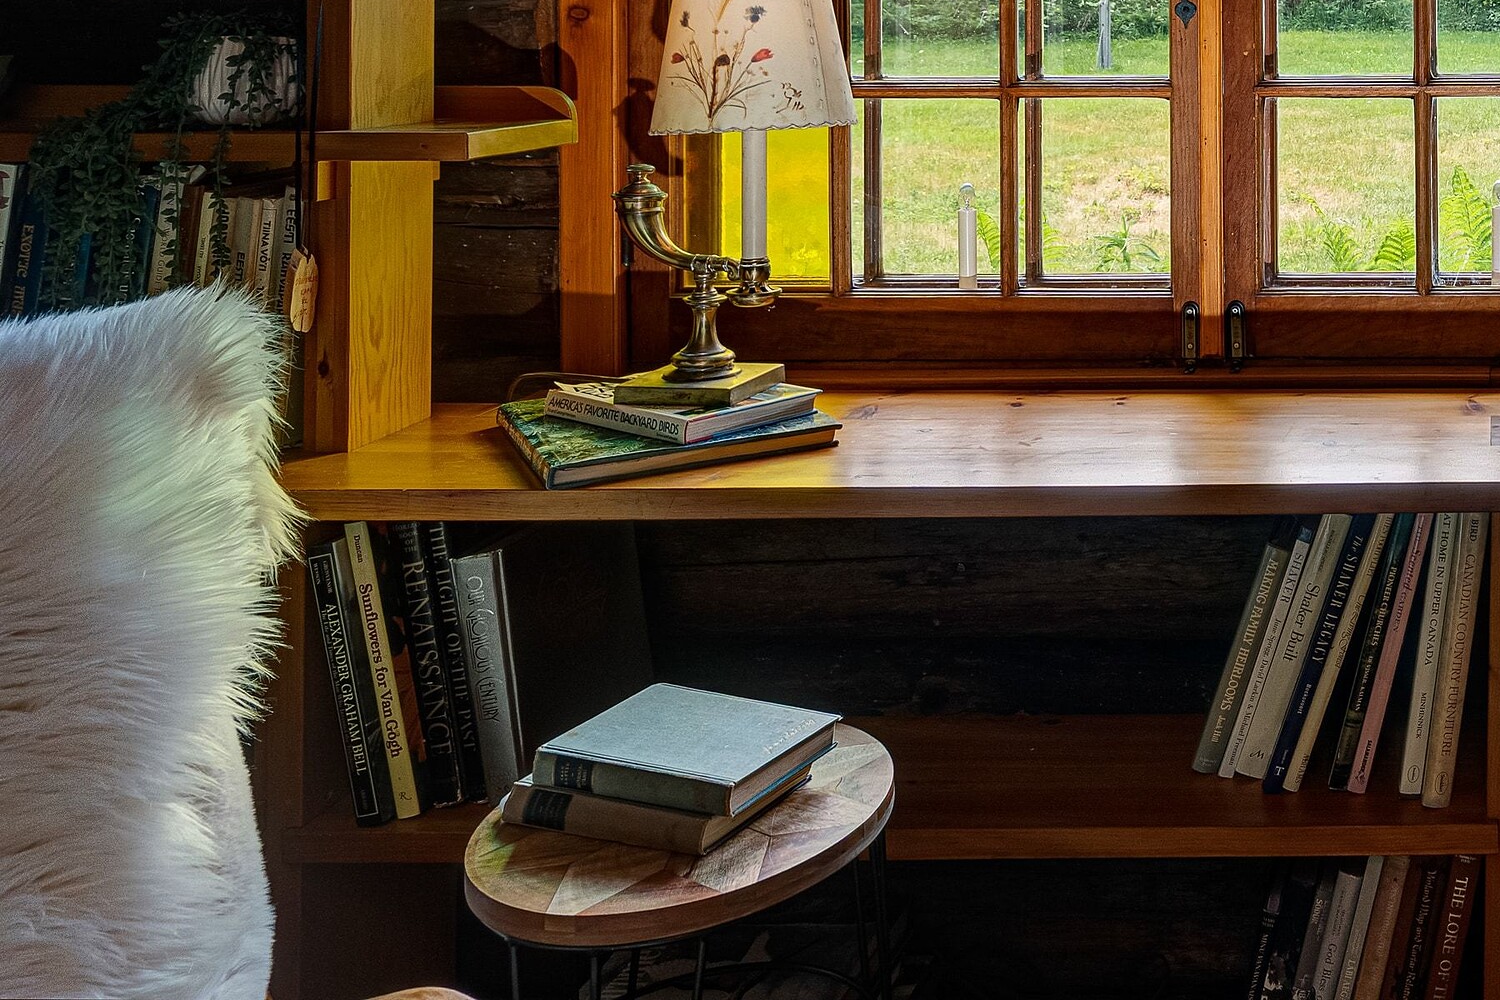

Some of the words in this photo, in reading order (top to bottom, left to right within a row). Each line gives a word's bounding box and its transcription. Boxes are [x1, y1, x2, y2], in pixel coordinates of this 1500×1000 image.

[261, 220, 271, 246] TIINA
[283, 208, 298, 244] EESTI
[15, 223, 35, 277] EXOTIC
[258, 248, 270, 271] VÕTI
[548, 395, 583, 413] AMERICA'S
[583, 403, 619, 421] FAVORITE
[619, 412, 657, 430] BACKYARD
[657, 420, 679, 435] BIRDS
[1442, 513, 1451, 528] AT
[1469, 518, 1479, 541] BIRD
[353, 535, 363, 563] Duncan
[428, 521, 448, 561] THE
[1350, 534, 1363, 553] The
[1437, 530, 1449, 562] HOME
[1254, 557, 1278, 605] MAKING
[1279, 551, 1304, 604] SHAKER
[1330, 553, 1357, 608] SHAKER
[1382, 565, 1397, 601] PIONEER
[1402, 548, 1421, 590] Scented
[1435, 565, 1445, 578] IN
[1458, 553, 1475, 619] CANADIAN
[435, 567, 457, 626] LIGHT
[465, 575, 485, 605] OUR
[1293, 582, 1321, 630] Shaker
[1430, 581, 1443, 615] UPPER
[358, 582, 385, 663] Sunflowers
[1241, 604, 1263, 645] FAMILY
[1270, 617, 1281, 634] Jane
[1370, 601, 1388, 646] CHURCHES
[1392, 591, 1407, 632] GARDEN
[445, 632, 462, 656] OF
[466, 607, 499, 673] GLORIOUS
[1261, 633, 1276, 658] Sprigg,
[1282, 629, 1305, 663] Built
[1311, 612, 1338, 664] LEGACY
[1424, 618, 1438, 666] CANADA
[1450, 622, 1467, 681] COUNTRY
[401, 558, 452, 757] RENAISSANCE
[1256, 659, 1269, 679] David
[325, 602, 349, 681] ALEXANDER
[340, 683, 360, 741] GRAHAM
[351, 743, 367, 775] BELL
[375, 666, 390, 688] for
[450, 663, 468, 700] THE
[1219, 646, 1250, 712] HEIRLOOMS
[1248, 680, 1262, 702] Larkin
[379, 689, 395, 718] Van
[475, 676, 503, 724] CENTURY
[1415, 692, 1427, 739] MINHINNICK
[382, 718, 402, 758] Gogh
[457, 709, 476, 752] PAST
[1210, 729, 1220, 742] Hill
[1214, 714, 1226, 731] Jack
[1237, 710, 1252, 737] Michael
[1440, 685, 1459, 756] FURNITURE
[1227, 737, 1242, 766] Freeman
[1449, 875, 1468, 909] THE
[1413, 926, 1424, 942] and
[1441, 913, 1461, 955] LORE
[1324, 943, 1337, 964] God
[1408, 943, 1421, 969] Tartar
[1437, 959, 1453, 981] OF
[1318, 968, 1331, 992] Bless
